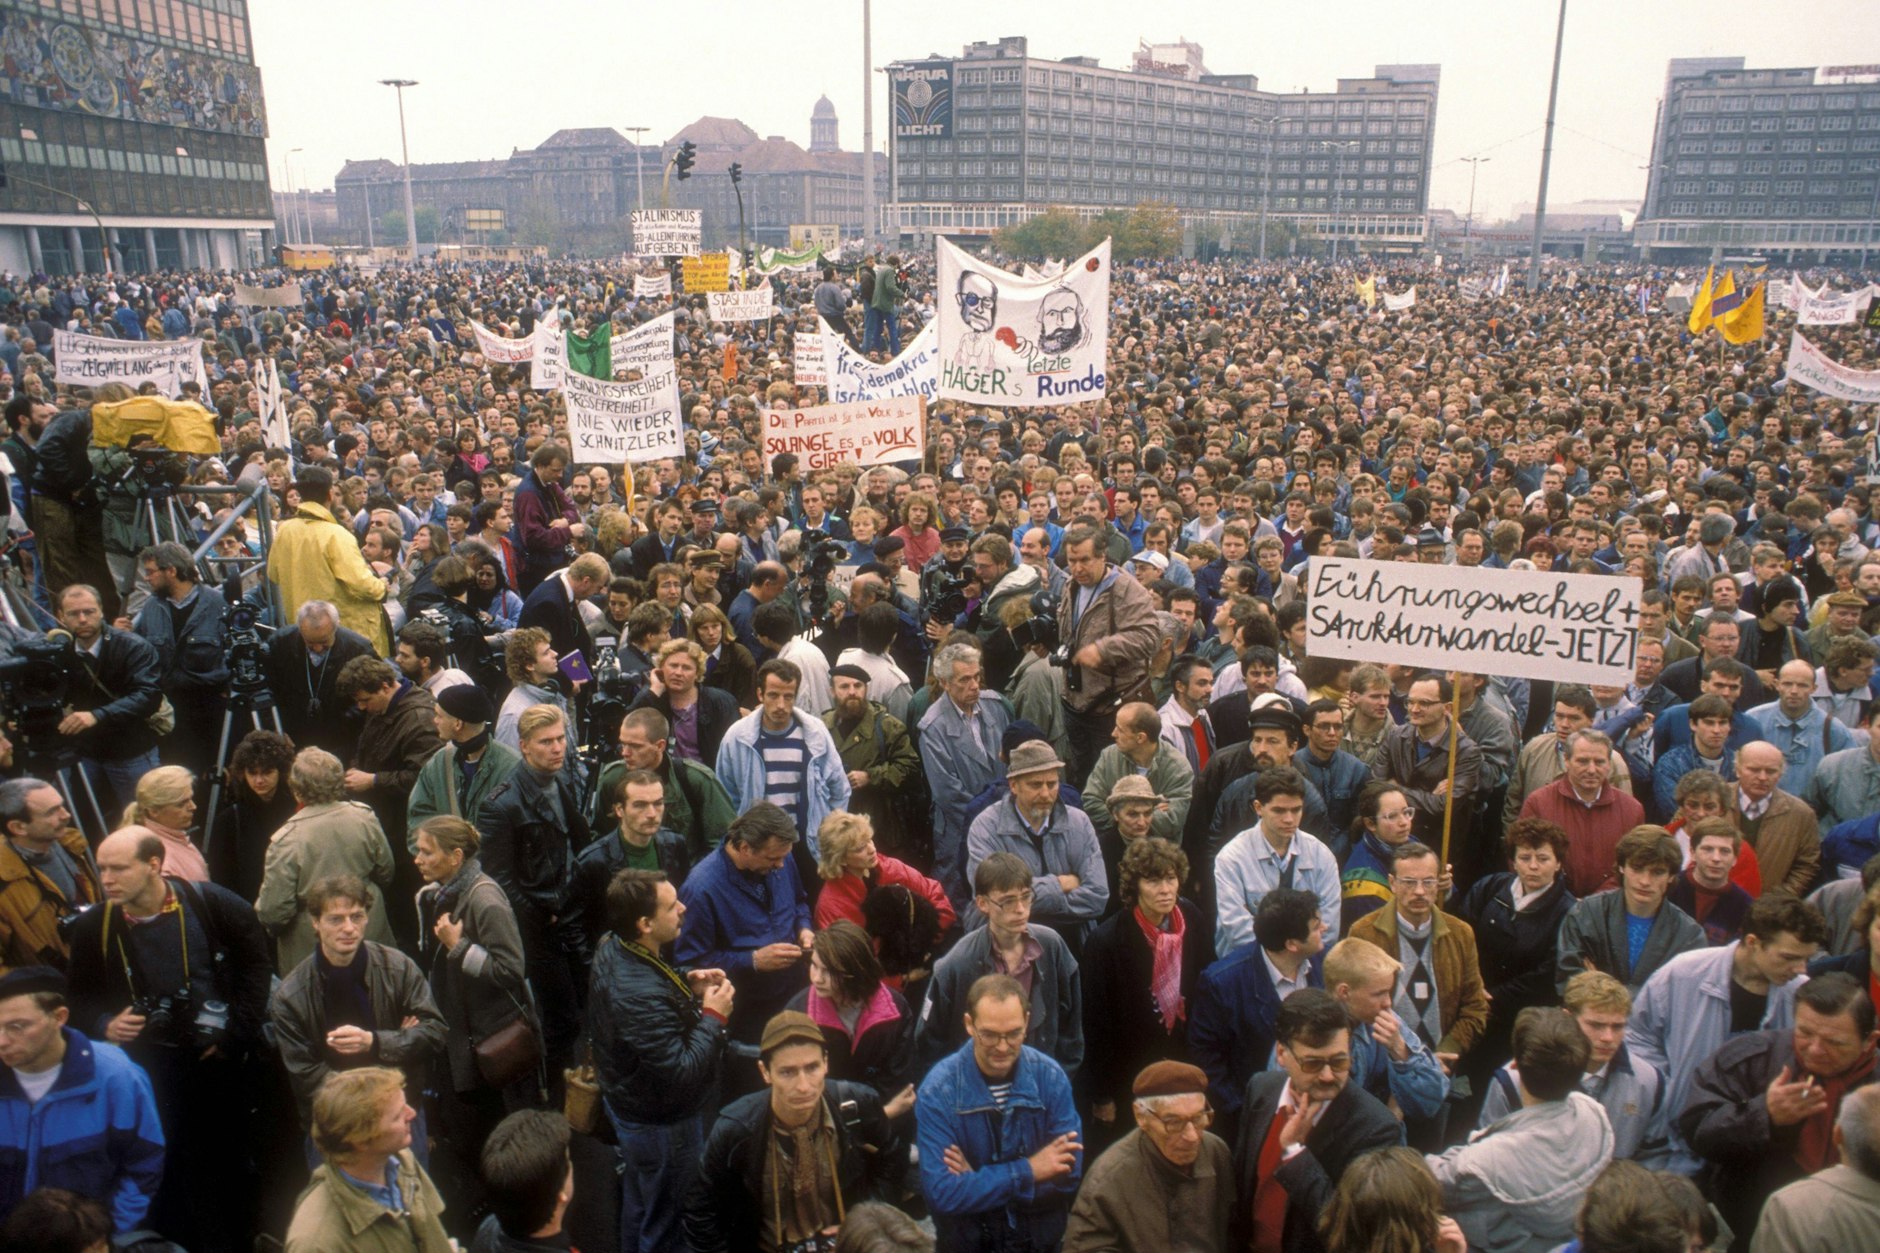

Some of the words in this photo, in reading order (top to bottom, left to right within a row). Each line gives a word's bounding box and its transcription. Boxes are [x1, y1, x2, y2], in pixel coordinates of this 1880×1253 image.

[897, 124, 944, 136] LICHT
[631, 209, 695, 223] STALINISMUS
[635, 242, 688, 254] AUFGEBEN
[712, 293, 739, 306] STASI
[720, 305, 770, 319] WIRTSCHAFT
[1807, 308, 1847, 321] ANGST
[131, 344, 166, 356] KURZE
[123, 360, 152, 376] LANG
[1037, 363, 1105, 398] Runde
[577, 412, 604, 431] NIE
[611, 410, 674, 433] WIEDER
[766, 431, 834, 455] SOLANGE
[839, 438, 854, 450] ES
[873, 426, 917, 446] VOLK
